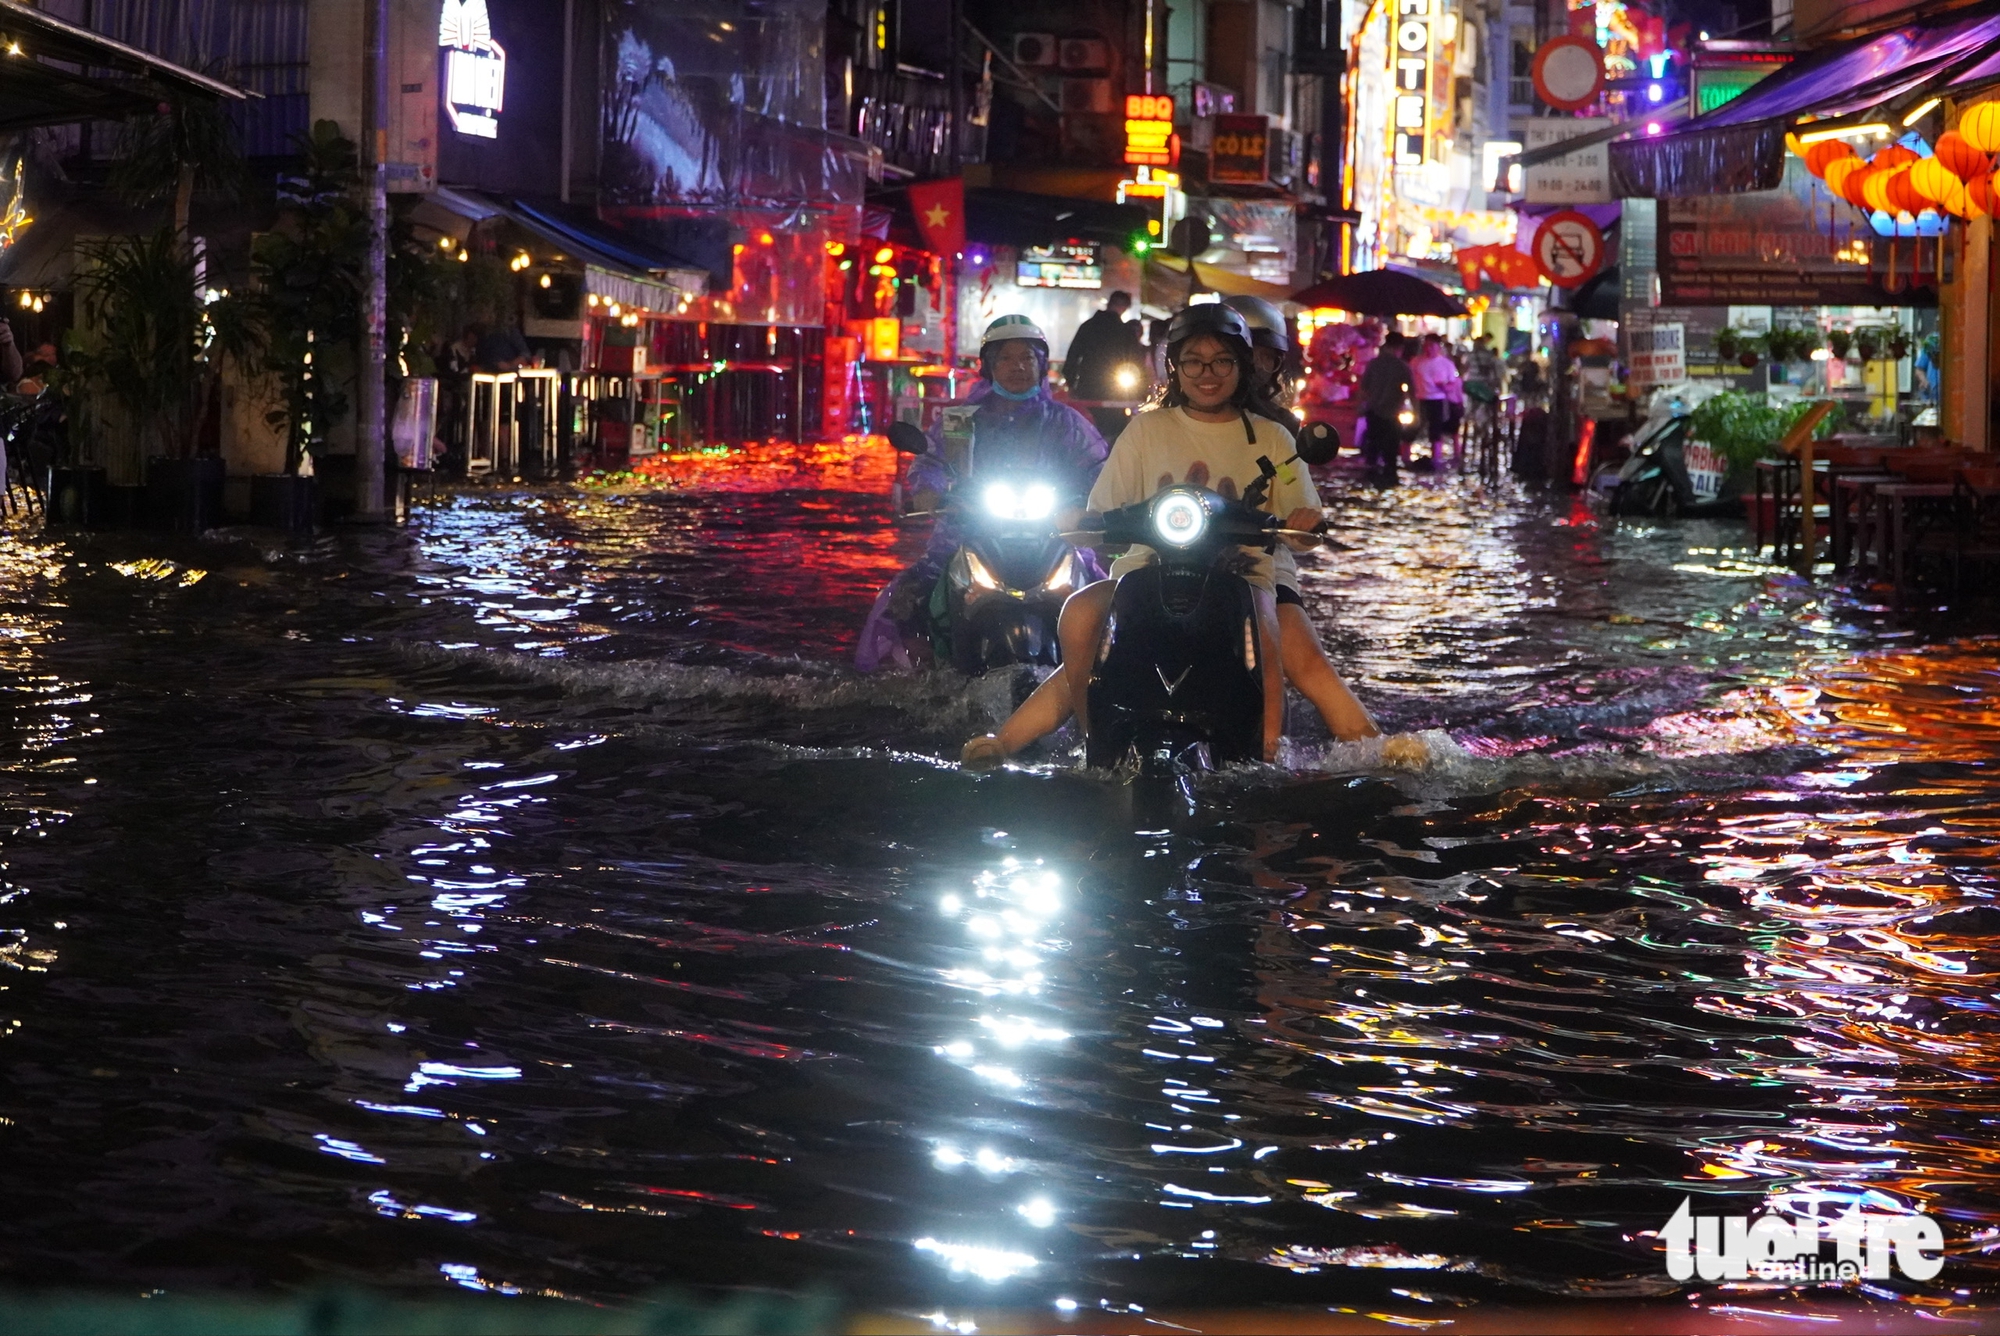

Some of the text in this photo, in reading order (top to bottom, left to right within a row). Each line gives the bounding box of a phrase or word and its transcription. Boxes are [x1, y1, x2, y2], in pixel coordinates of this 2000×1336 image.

[1125, 95, 1174, 120] BBQ
[1630, 329, 1681, 352] MOTORBIKE
[1654, 353, 1678, 367] RENT
